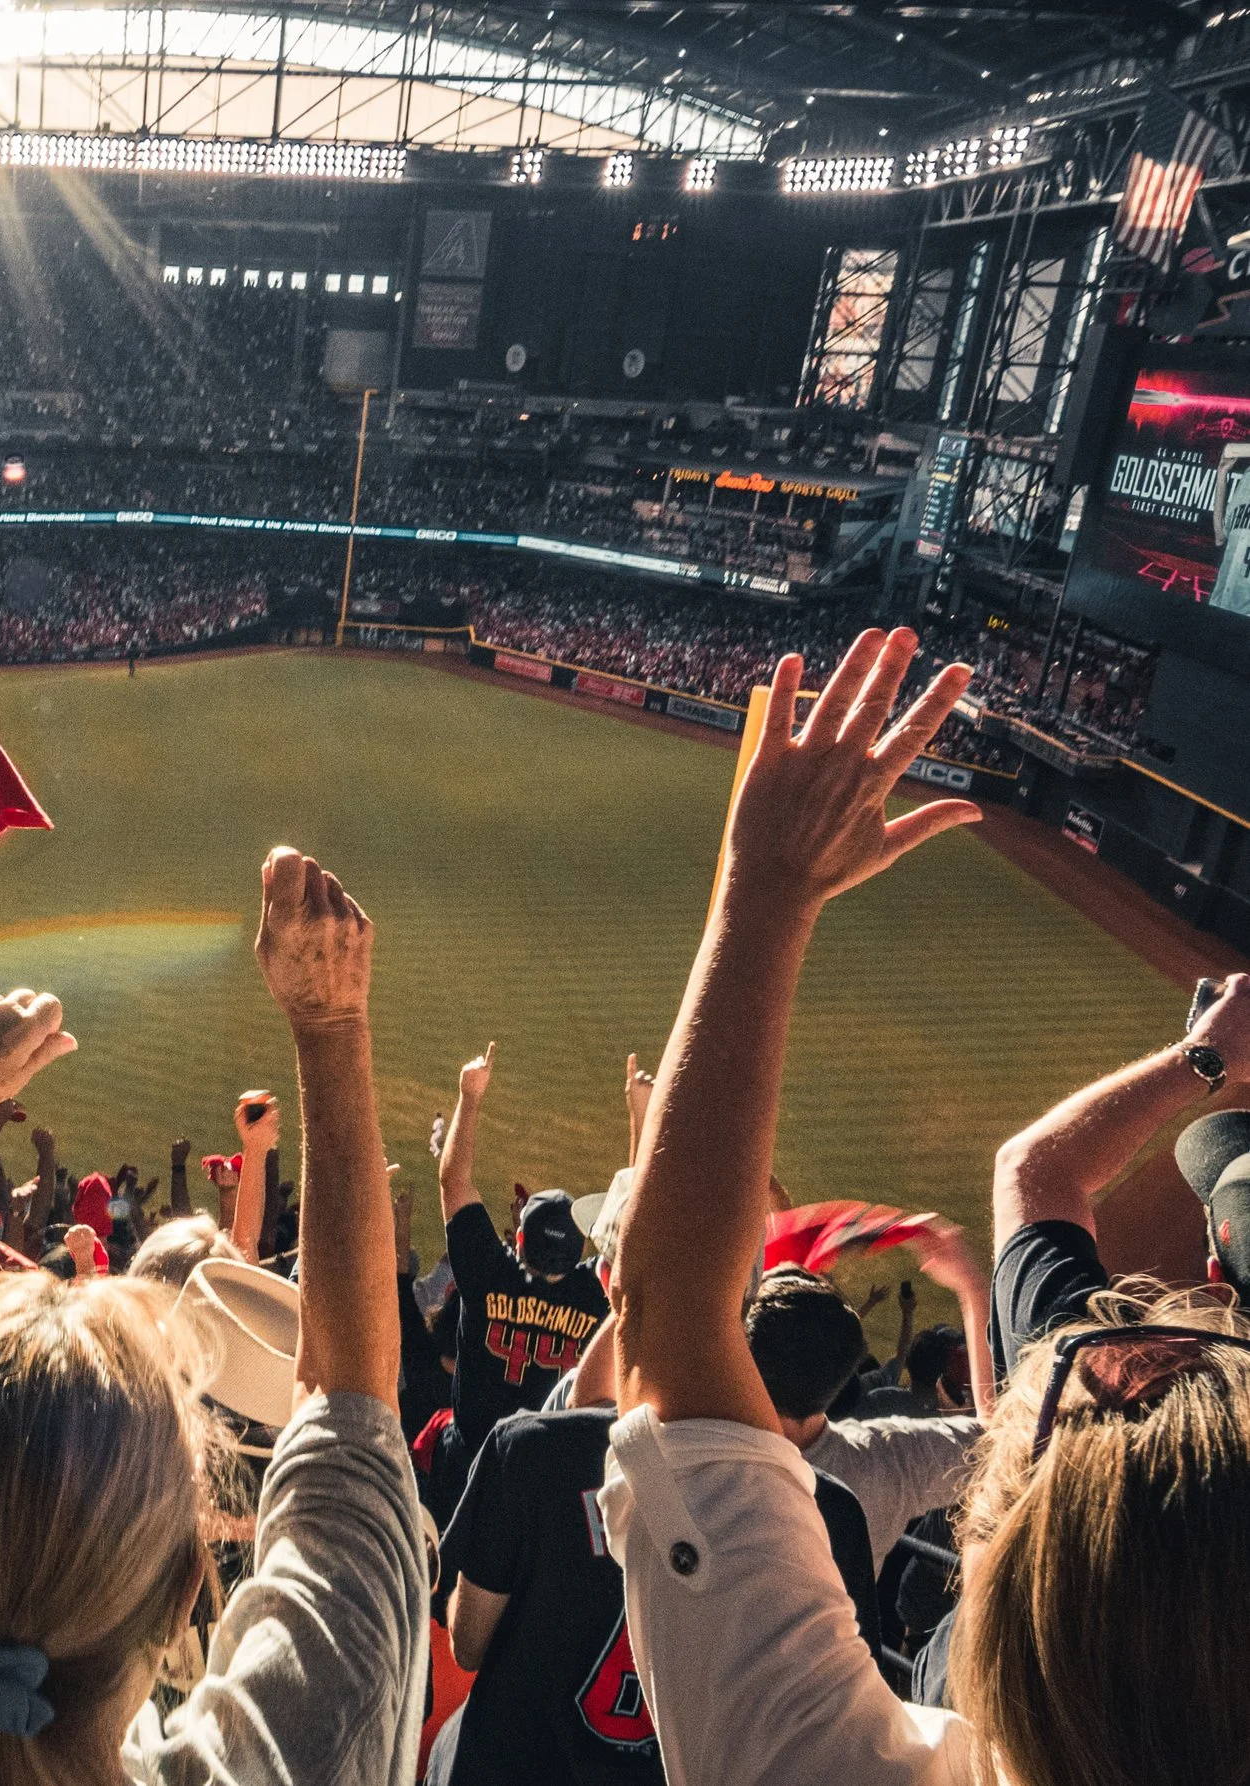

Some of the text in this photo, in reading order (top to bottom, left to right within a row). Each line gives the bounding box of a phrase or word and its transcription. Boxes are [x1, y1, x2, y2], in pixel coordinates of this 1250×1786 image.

[1180, 450, 1204, 464] PAUL
[780, 479, 823, 497] SPORTS
[826, 486, 859, 501] GRILL
[26, 512, 86, 523] Diamondbacks
[116, 511, 154, 523] GEICO
[1131, 499, 1200, 523] FIRST BASEMAN
[190, 515, 218, 526] Proud
[218, 516, 254, 528] Partner
[265, 518, 282, 529] the
[283, 520, 317, 533] Arizona
[317, 523, 382, 536] Diamonbacks
[415, 528, 458, 541] GEICO
[905, 757, 972, 788] EICO
[485, 1292, 598, 1340] GOLDSCHMIDT
